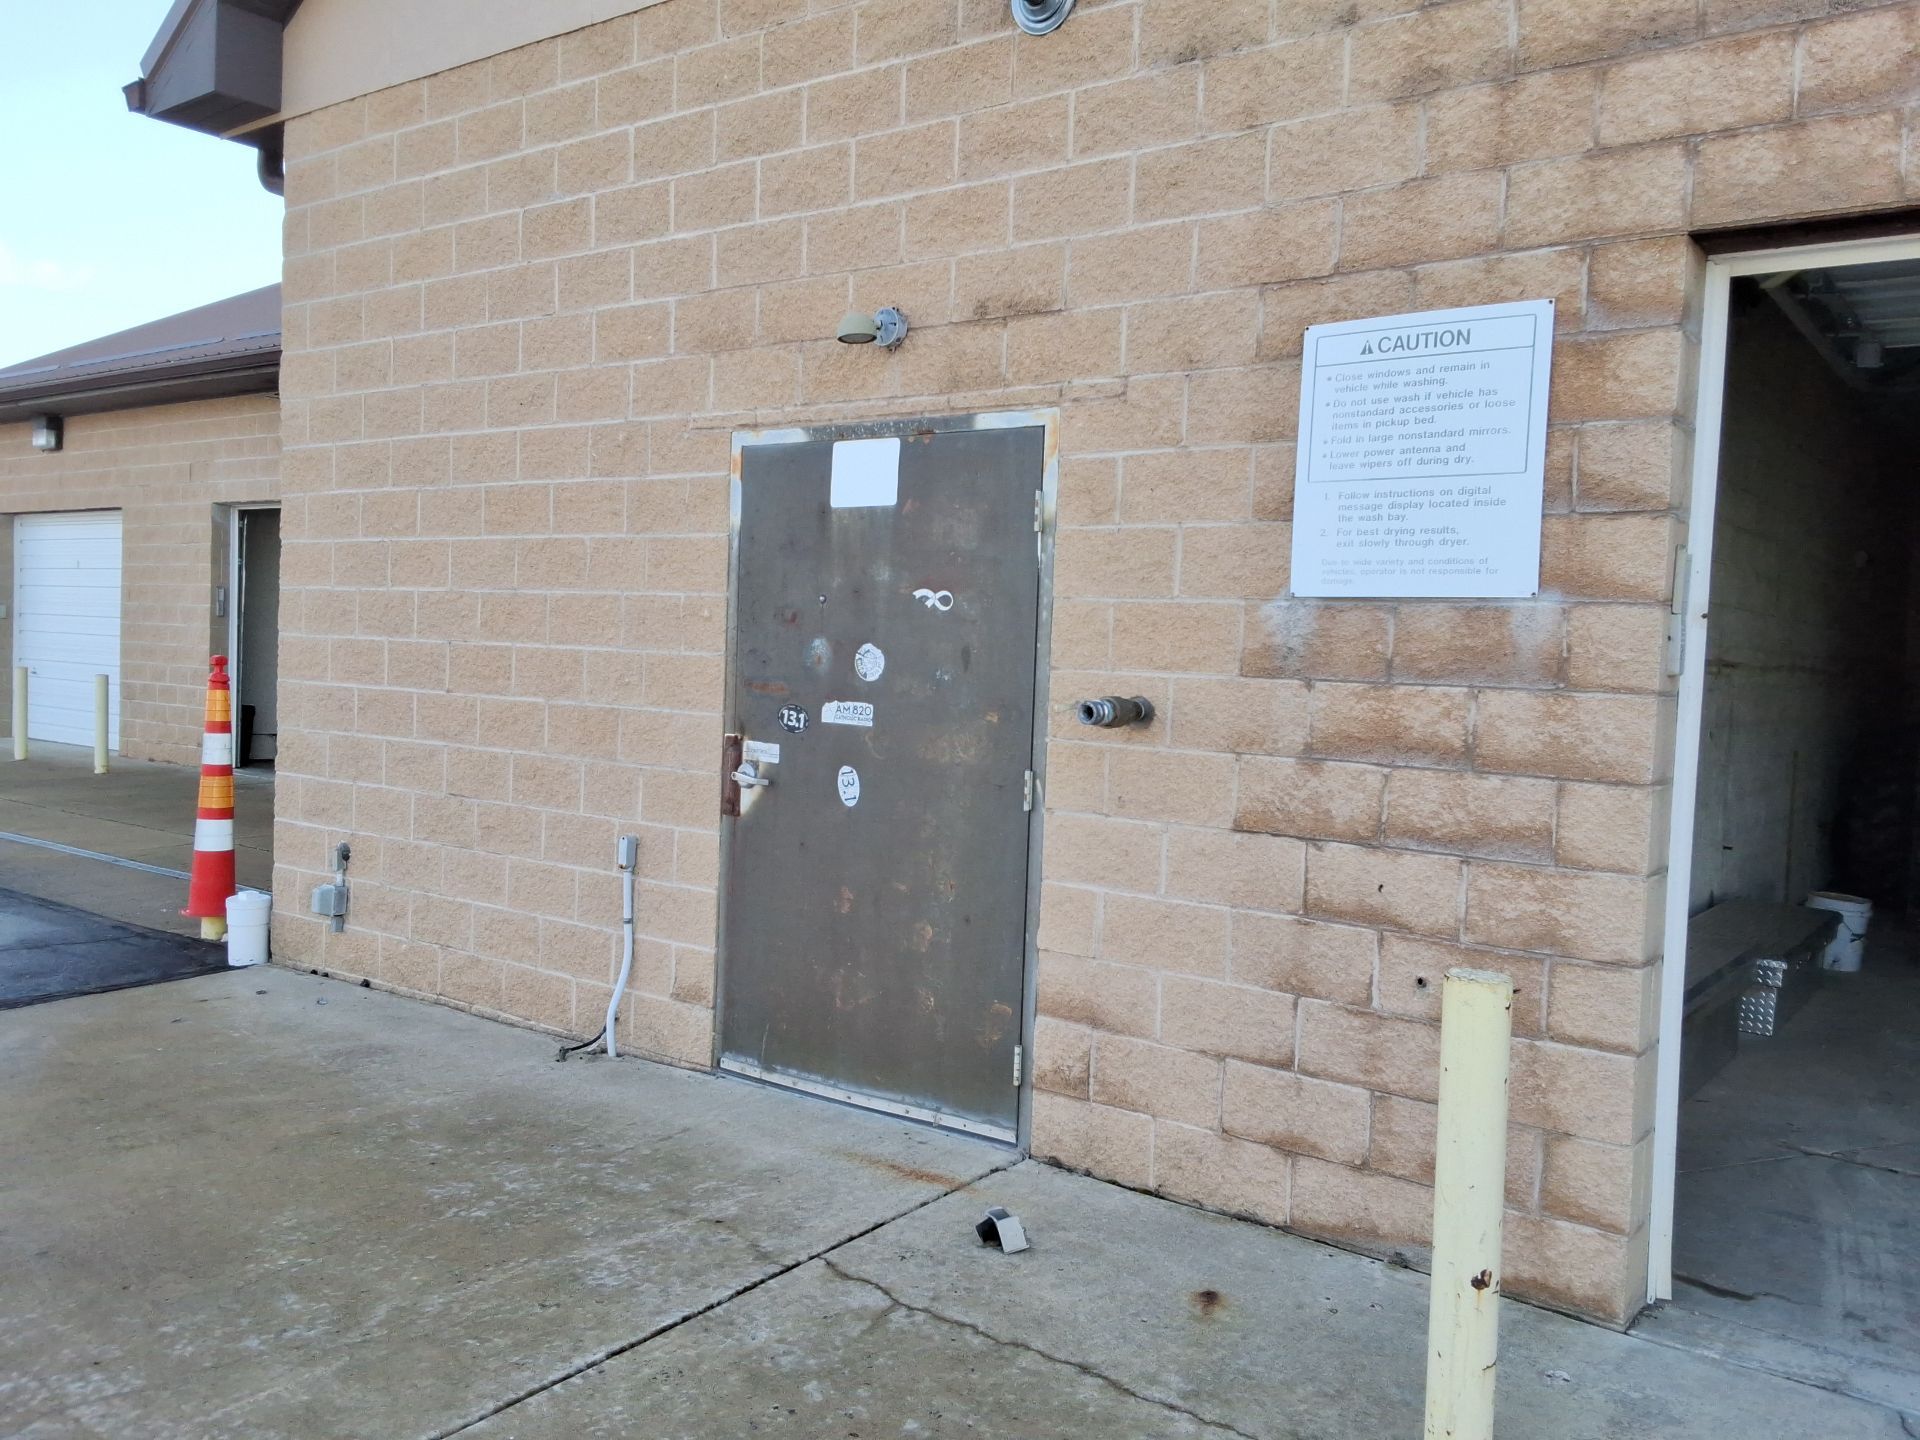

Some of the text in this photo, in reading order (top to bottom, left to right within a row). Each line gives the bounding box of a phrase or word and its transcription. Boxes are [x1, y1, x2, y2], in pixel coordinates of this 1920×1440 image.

[1378, 328, 1471, 353] CAUTION
[1335, 361, 1490, 382] Close windows and remain in
[1335, 376, 1448, 394] vehicle while washing.
[1333, 400, 1346, 408] Do
[1394, 394, 1419, 403] wash
[1425, 392, 1431, 400] if
[1437, 390, 1473, 400] vehicle
[1478, 388, 1498, 396] has
[1333, 408, 1394, 419] nonstandard
[1399, 402, 1463, 414] accessories
[1485, 399, 1516, 408] loose
[1332, 422, 1358, 431] items
[1375, 417, 1409, 429] pickup
[1414, 416, 1436, 425] bed.
[1331, 426, 1511, 445] Fold in large nonstandard mirrors.
[1330, 444, 1465, 459] Lower power antenna and
[1330, 454, 1474, 471] leave wipers off during dry.
[1339, 491, 1369, 500] Follow
[1374, 489, 1434, 498] instructions
[1440, 488, 1453, 496] on
[1458, 486, 1491, 497] digital
[1339, 498, 1506, 512] message display located inside
[1339, 513, 1408, 522] the wash bay.
[1337, 528, 1352, 537] For
[1357, 528, 1379, 536] best
[1384, 527, 1415, 536] drying
[1337, 537, 1469, 548] exit slowly through dryer.
[1376, 558, 1404, 566] variety
[1479, 557, 1488, 565] of
[1360, 568, 1396, 576] operator
[1429, 567, 1481, 576] responsible
[836, 705, 872, 716] AM 820
[782, 710, 805, 728] 13.1
[840, 769, 857, 802] 13.1
